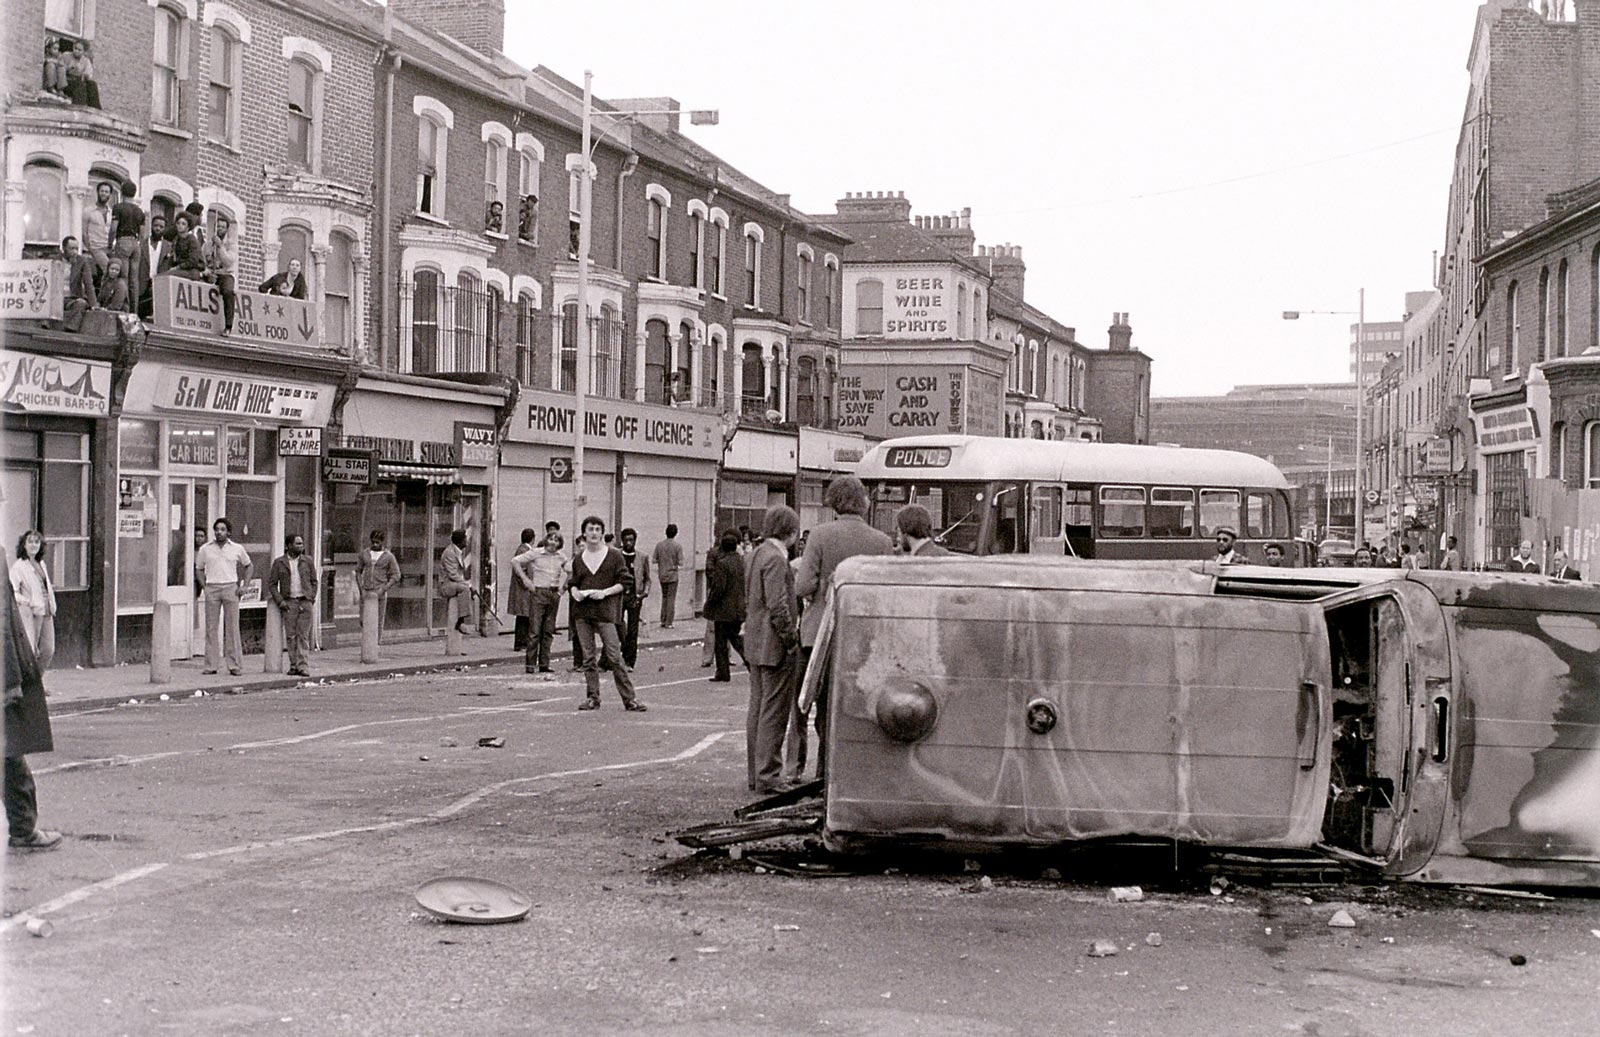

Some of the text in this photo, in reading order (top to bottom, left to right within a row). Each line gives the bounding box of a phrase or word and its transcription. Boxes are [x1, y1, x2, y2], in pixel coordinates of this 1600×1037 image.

[18, 282, 28, 294] &
[896, 278, 944, 290] BEER
[175, 282, 253, 321] ALLSAR
[895, 295, 942, 308] WINE
[238, 320, 289, 340] SOUL FOOD
[886, 320, 947, 333] SPIRITS
[840, 376, 862, 389] THE
[895, 376, 938, 392] CASH
[16, 392, 60, 407] CHICKEN
[213, 380, 243, 411] CAR
[244, 383, 277, 414] HIRE
[862, 389, 885, 401] WAY
[845, 402, 875, 414] SAVE
[898, 395, 929, 409] AND
[888, 411, 941, 427] CARRY
[463, 427, 494, 442] WAVY
[614, 415, 638, 440] OFF
[645, 418, 694, 446] LICENCE
[280, 439, 320, 450] CAR HIRE
[169, 445, 190, 462] CAR
[193, 445, 215, 463] HIRE
[463, 448, 494, 461] LINE
[893, 448, 948, 466] POLICE
[323, 459, 368, 470] ALL STAR
[331, 472, 368, 481] TAKE AWAY
